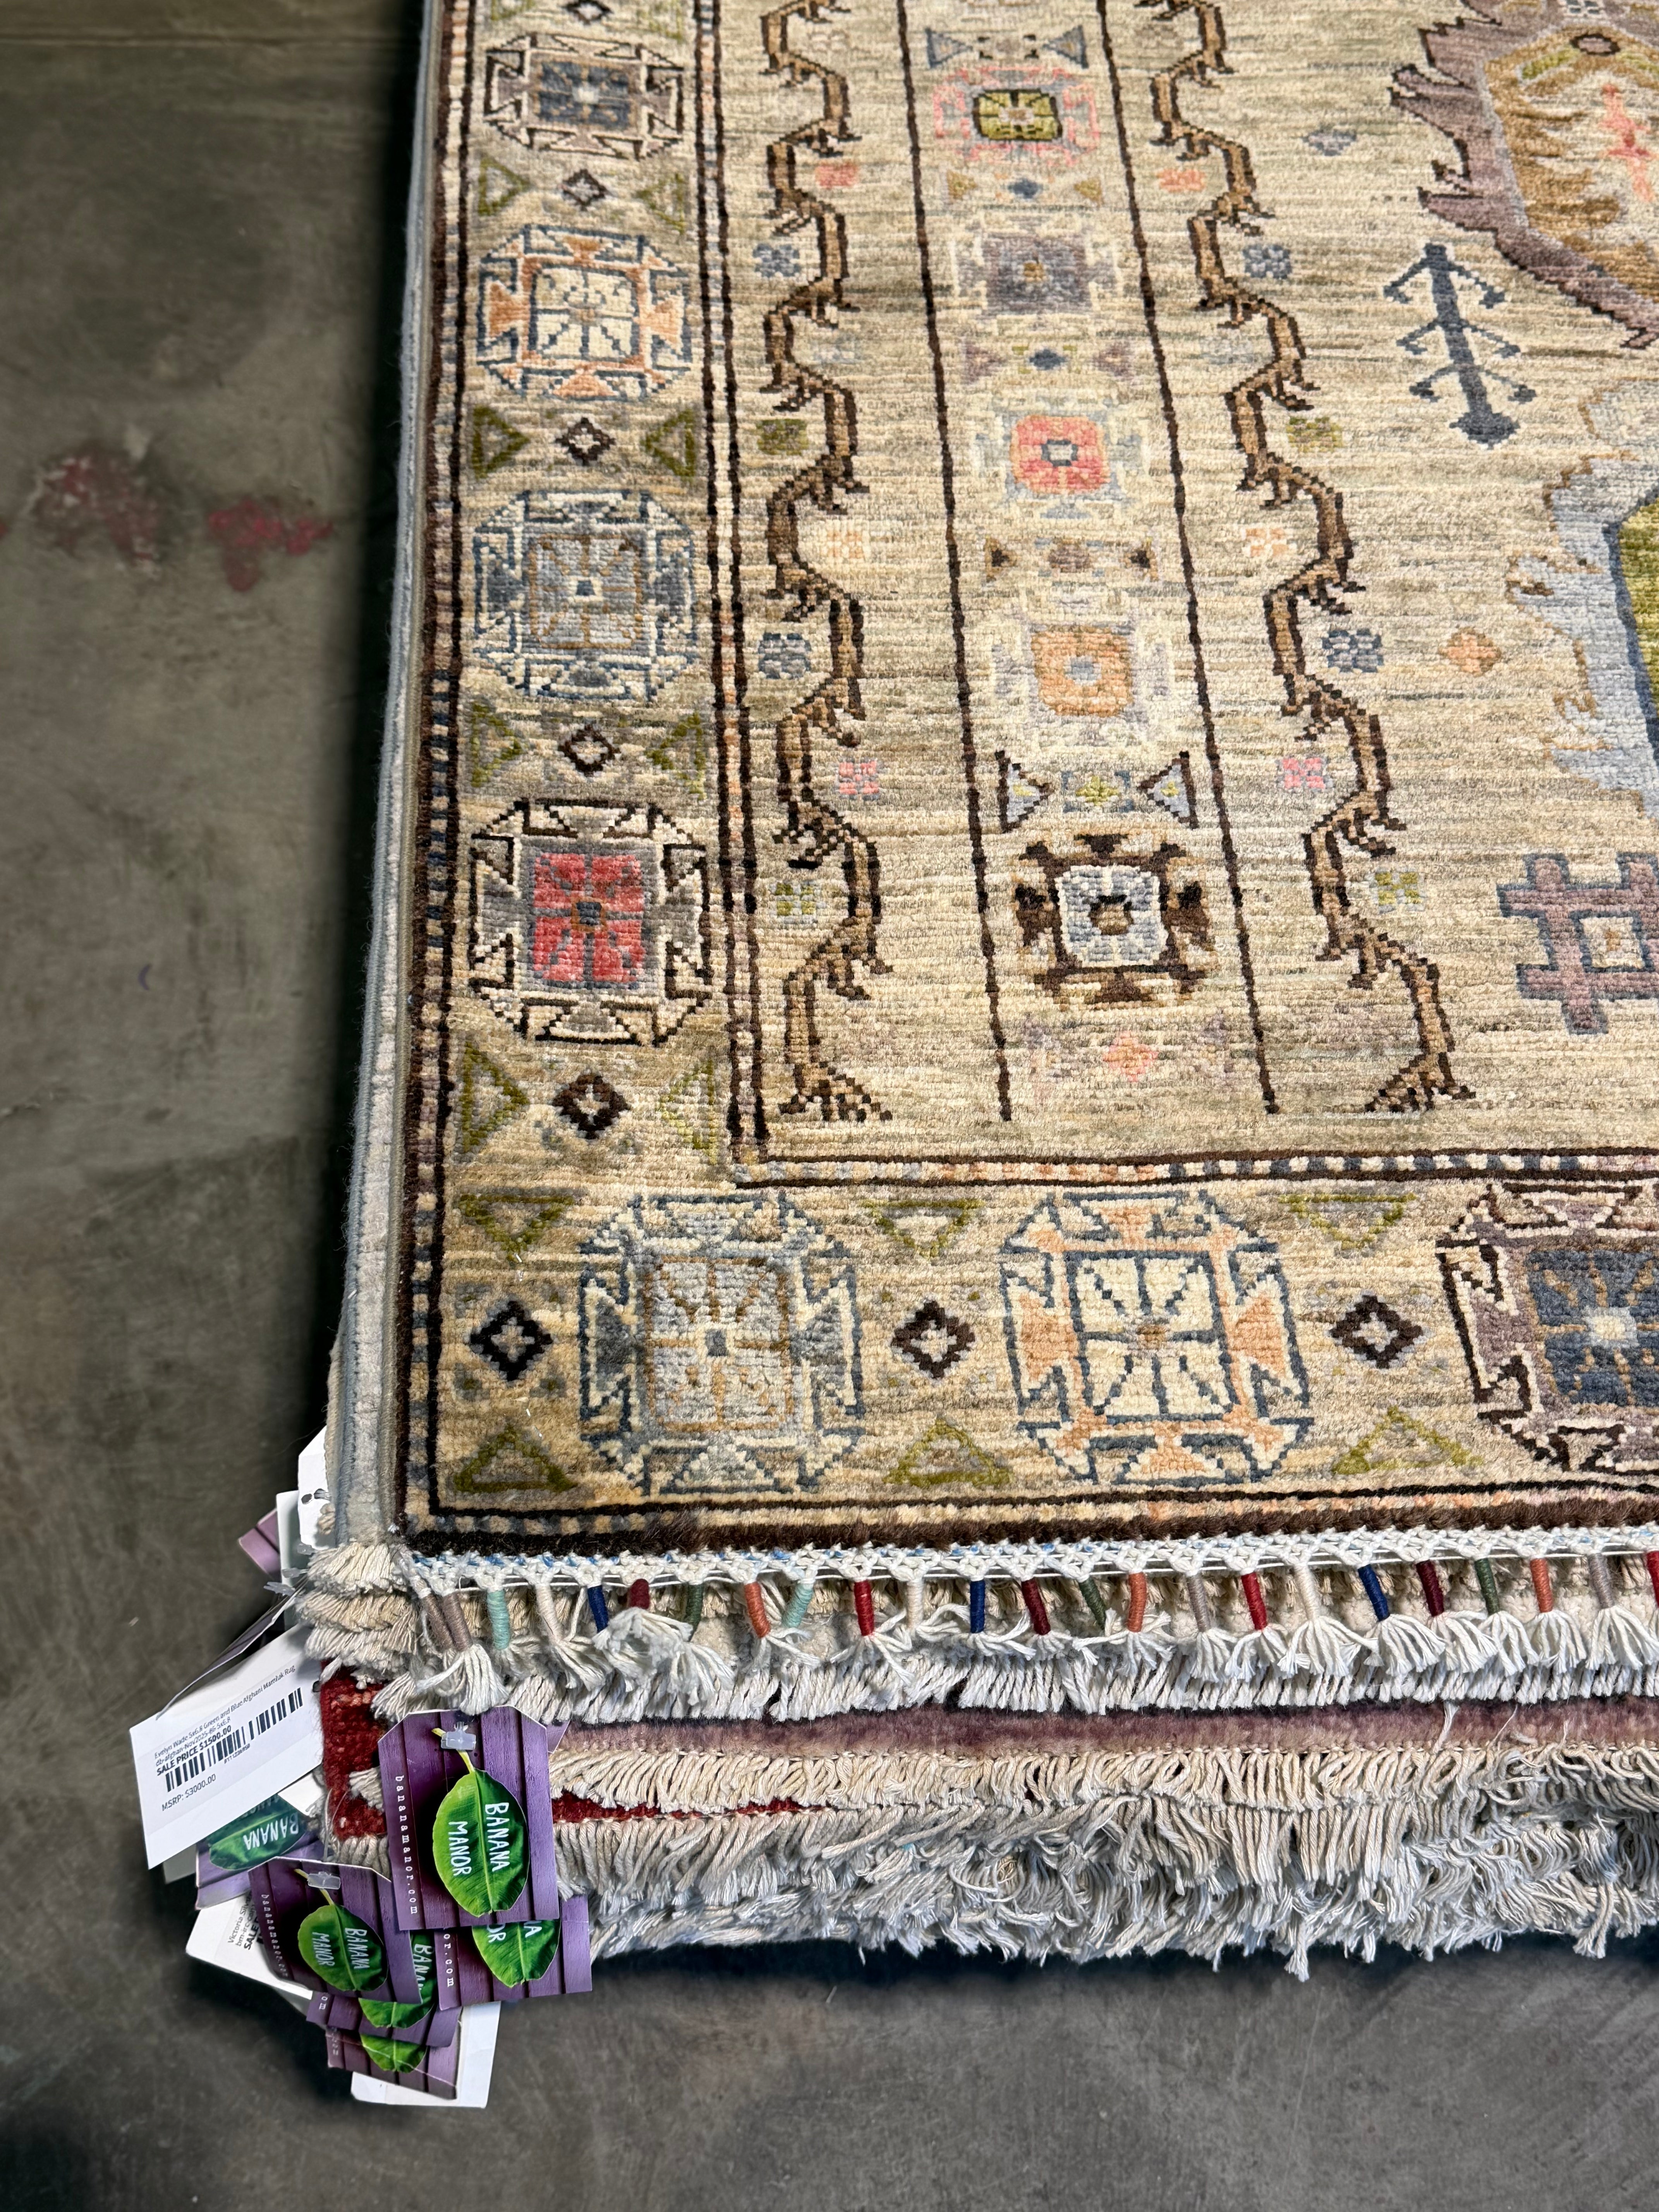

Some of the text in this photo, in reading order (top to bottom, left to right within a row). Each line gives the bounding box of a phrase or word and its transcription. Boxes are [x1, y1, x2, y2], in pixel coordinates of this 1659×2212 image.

[155, 1744, 172, 1759] Evelyn
[203, 1716, 220, 1729] Green
[220, 1707, 230, 1719] and
[231, 1701, 242, 1712] Blue
[244, 1686, 263, 1703] Afghani
[285, 1665, 295, 1675] Rug
[157, 1725, 231, 1776] SALE PRICE $1500.00
[162, 1774, 216, 1812] MSRP: $3000.00
[243, 1812, 299, 1850] BANANA
[395, 1775, 417, 1914] bananamanor.com
[448, 1821, 472, 1876] MANOR
[485, 1802, 510, 1872] BANANA
[228, 1917, 243, 1943] Victoria
[244, 1924, 259, 1950] SALE
[261, 1894, 288, 1977] bananamanor.com
[312, 1932, 335, 1966] MANOR
[345, 1927, 370, 1969] BANANA
